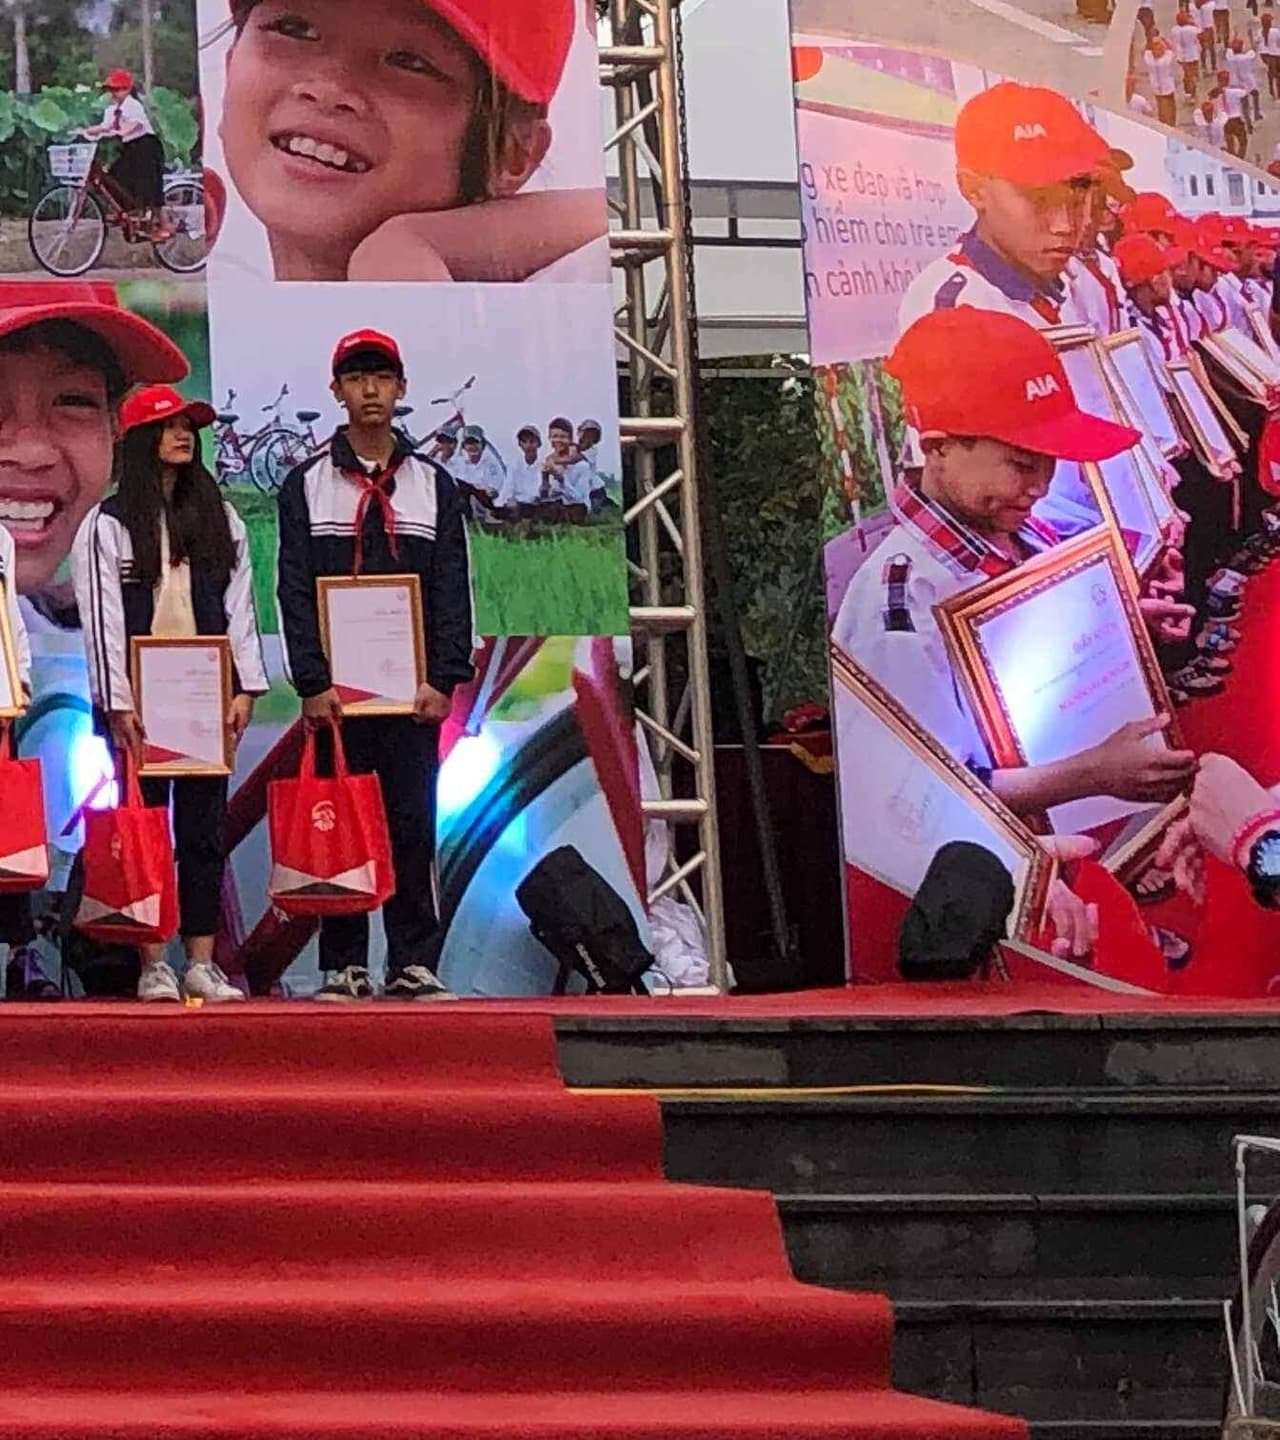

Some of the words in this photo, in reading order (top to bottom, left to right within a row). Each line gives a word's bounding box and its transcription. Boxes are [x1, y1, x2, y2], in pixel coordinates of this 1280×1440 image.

[1014, 123, 1048, 141] AIA
[822, 165, 848, 193] xe
[874, 212, 908, 247] cho
[1025, 373, 1061, 401] AIA
